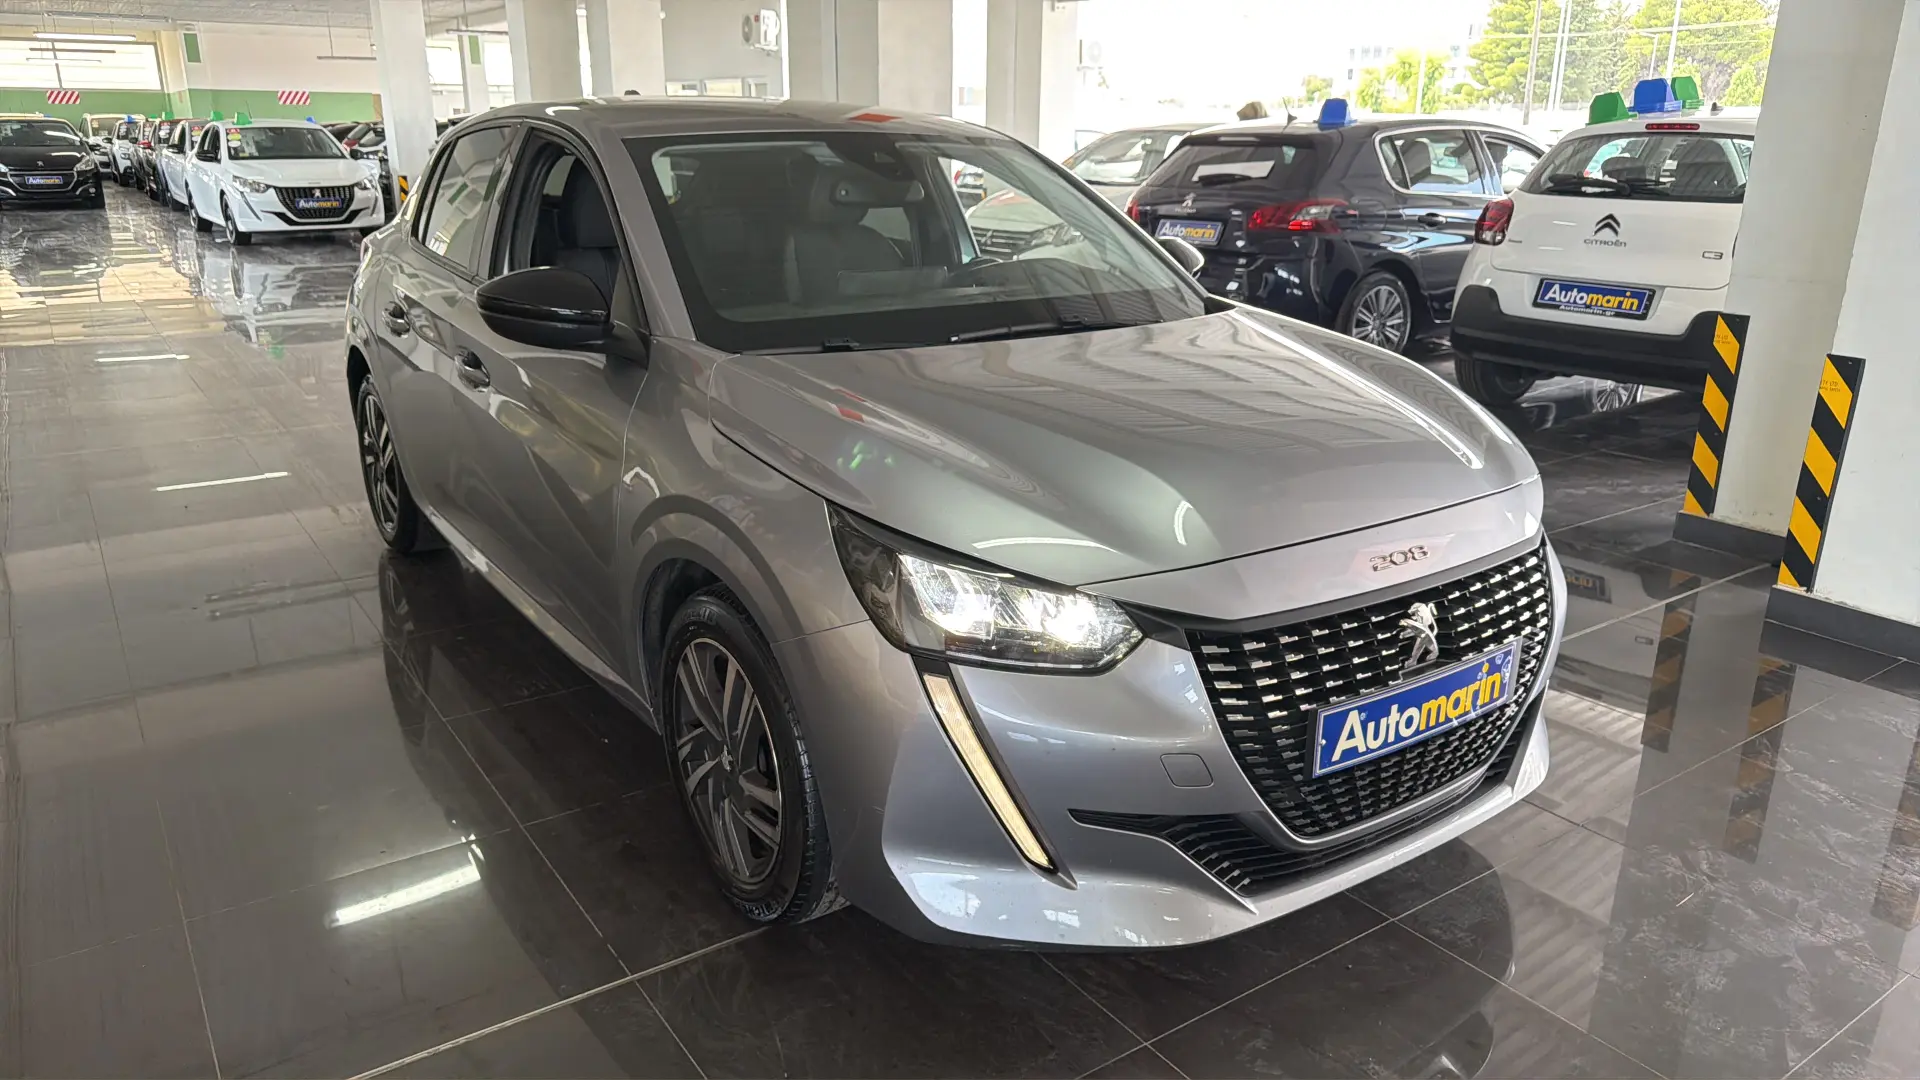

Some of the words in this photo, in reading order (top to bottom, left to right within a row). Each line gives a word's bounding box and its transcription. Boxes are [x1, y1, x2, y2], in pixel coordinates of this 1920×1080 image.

[299, 199, 339, 208] Automarin
[1160, 221, 1216, 238] Automarin
[1702, 250, 1724, 260] C3
[1544, 283, 1639, 311] Automarin
[1369, 545, 1431, 572] 208
[1331, 662, 1501, 762] Automarin
